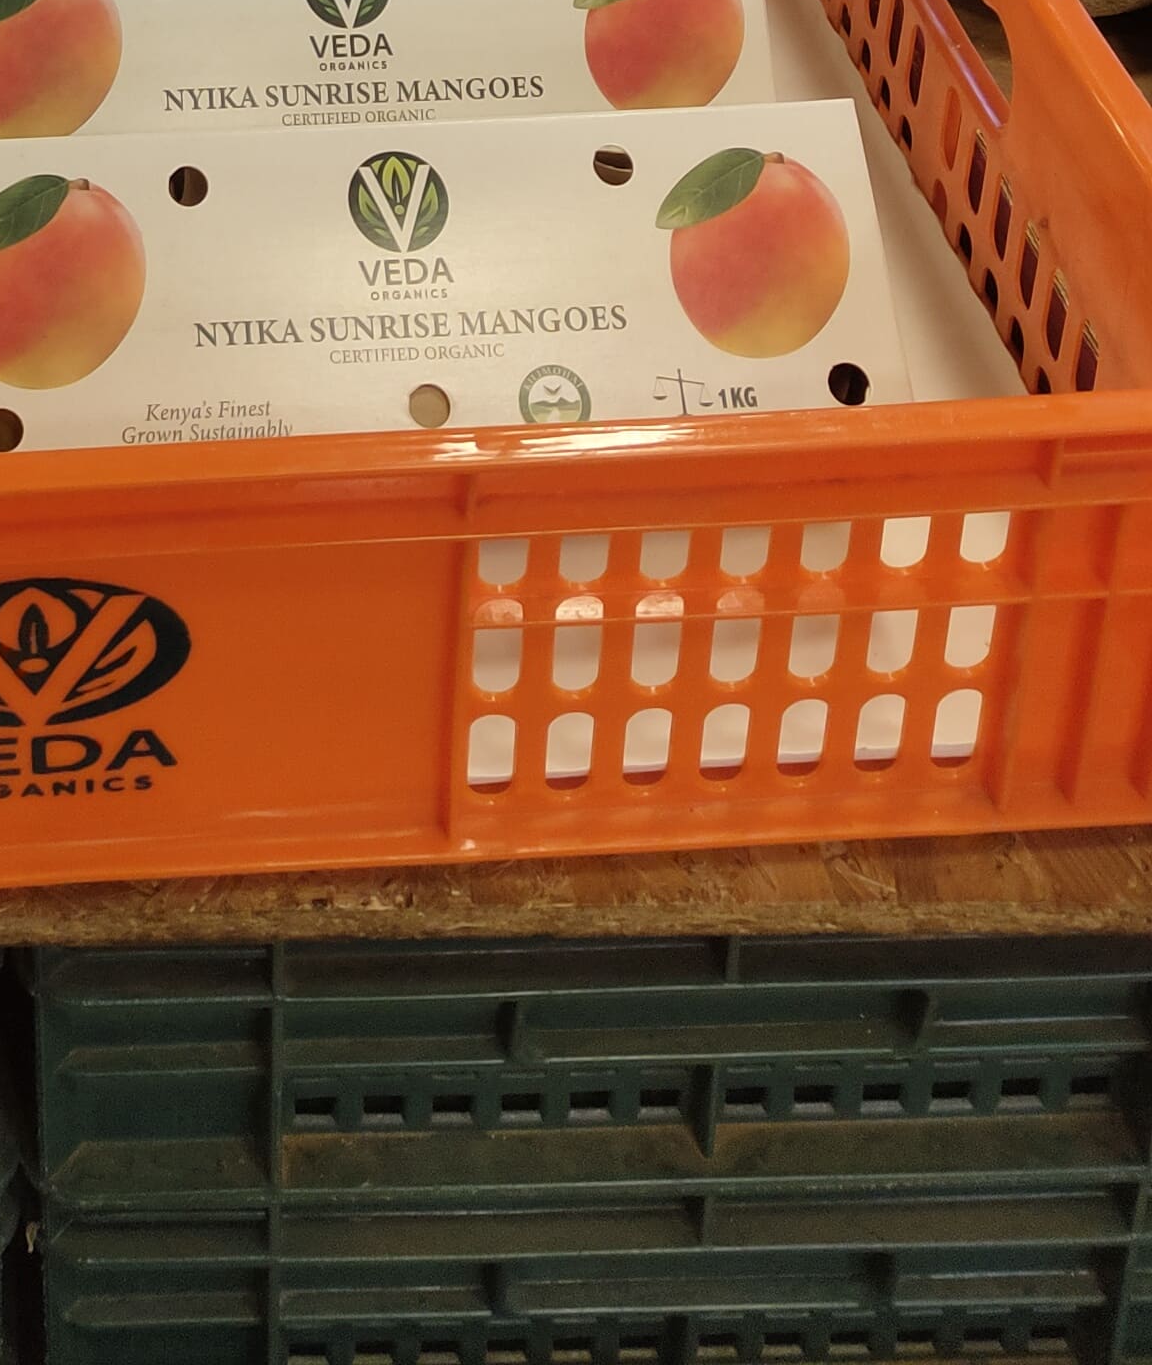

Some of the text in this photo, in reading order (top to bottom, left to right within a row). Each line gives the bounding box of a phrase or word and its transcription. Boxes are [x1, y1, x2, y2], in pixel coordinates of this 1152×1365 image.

[309, 33, 393, 58] VEDA
[319, 60, 388, 72] ORGANICS
[163, 75, 545, 112] NYIKA SUNRISE MANGOES
[281, 108, 436, 127] CERTIFIED ORGANIC
[358, 257, 454, 286] VEDA
[370, 288, 448, 301] ORGANICS
[193, 304, 627, 348] NYIKA SUNRISE MANGOES
[329, 342, 505, 365] CERTIFIED ORGANIC
[145, 400, 272, 425] Kenya's Finest
[122, 419, 293, 444] Grown Sustainably
